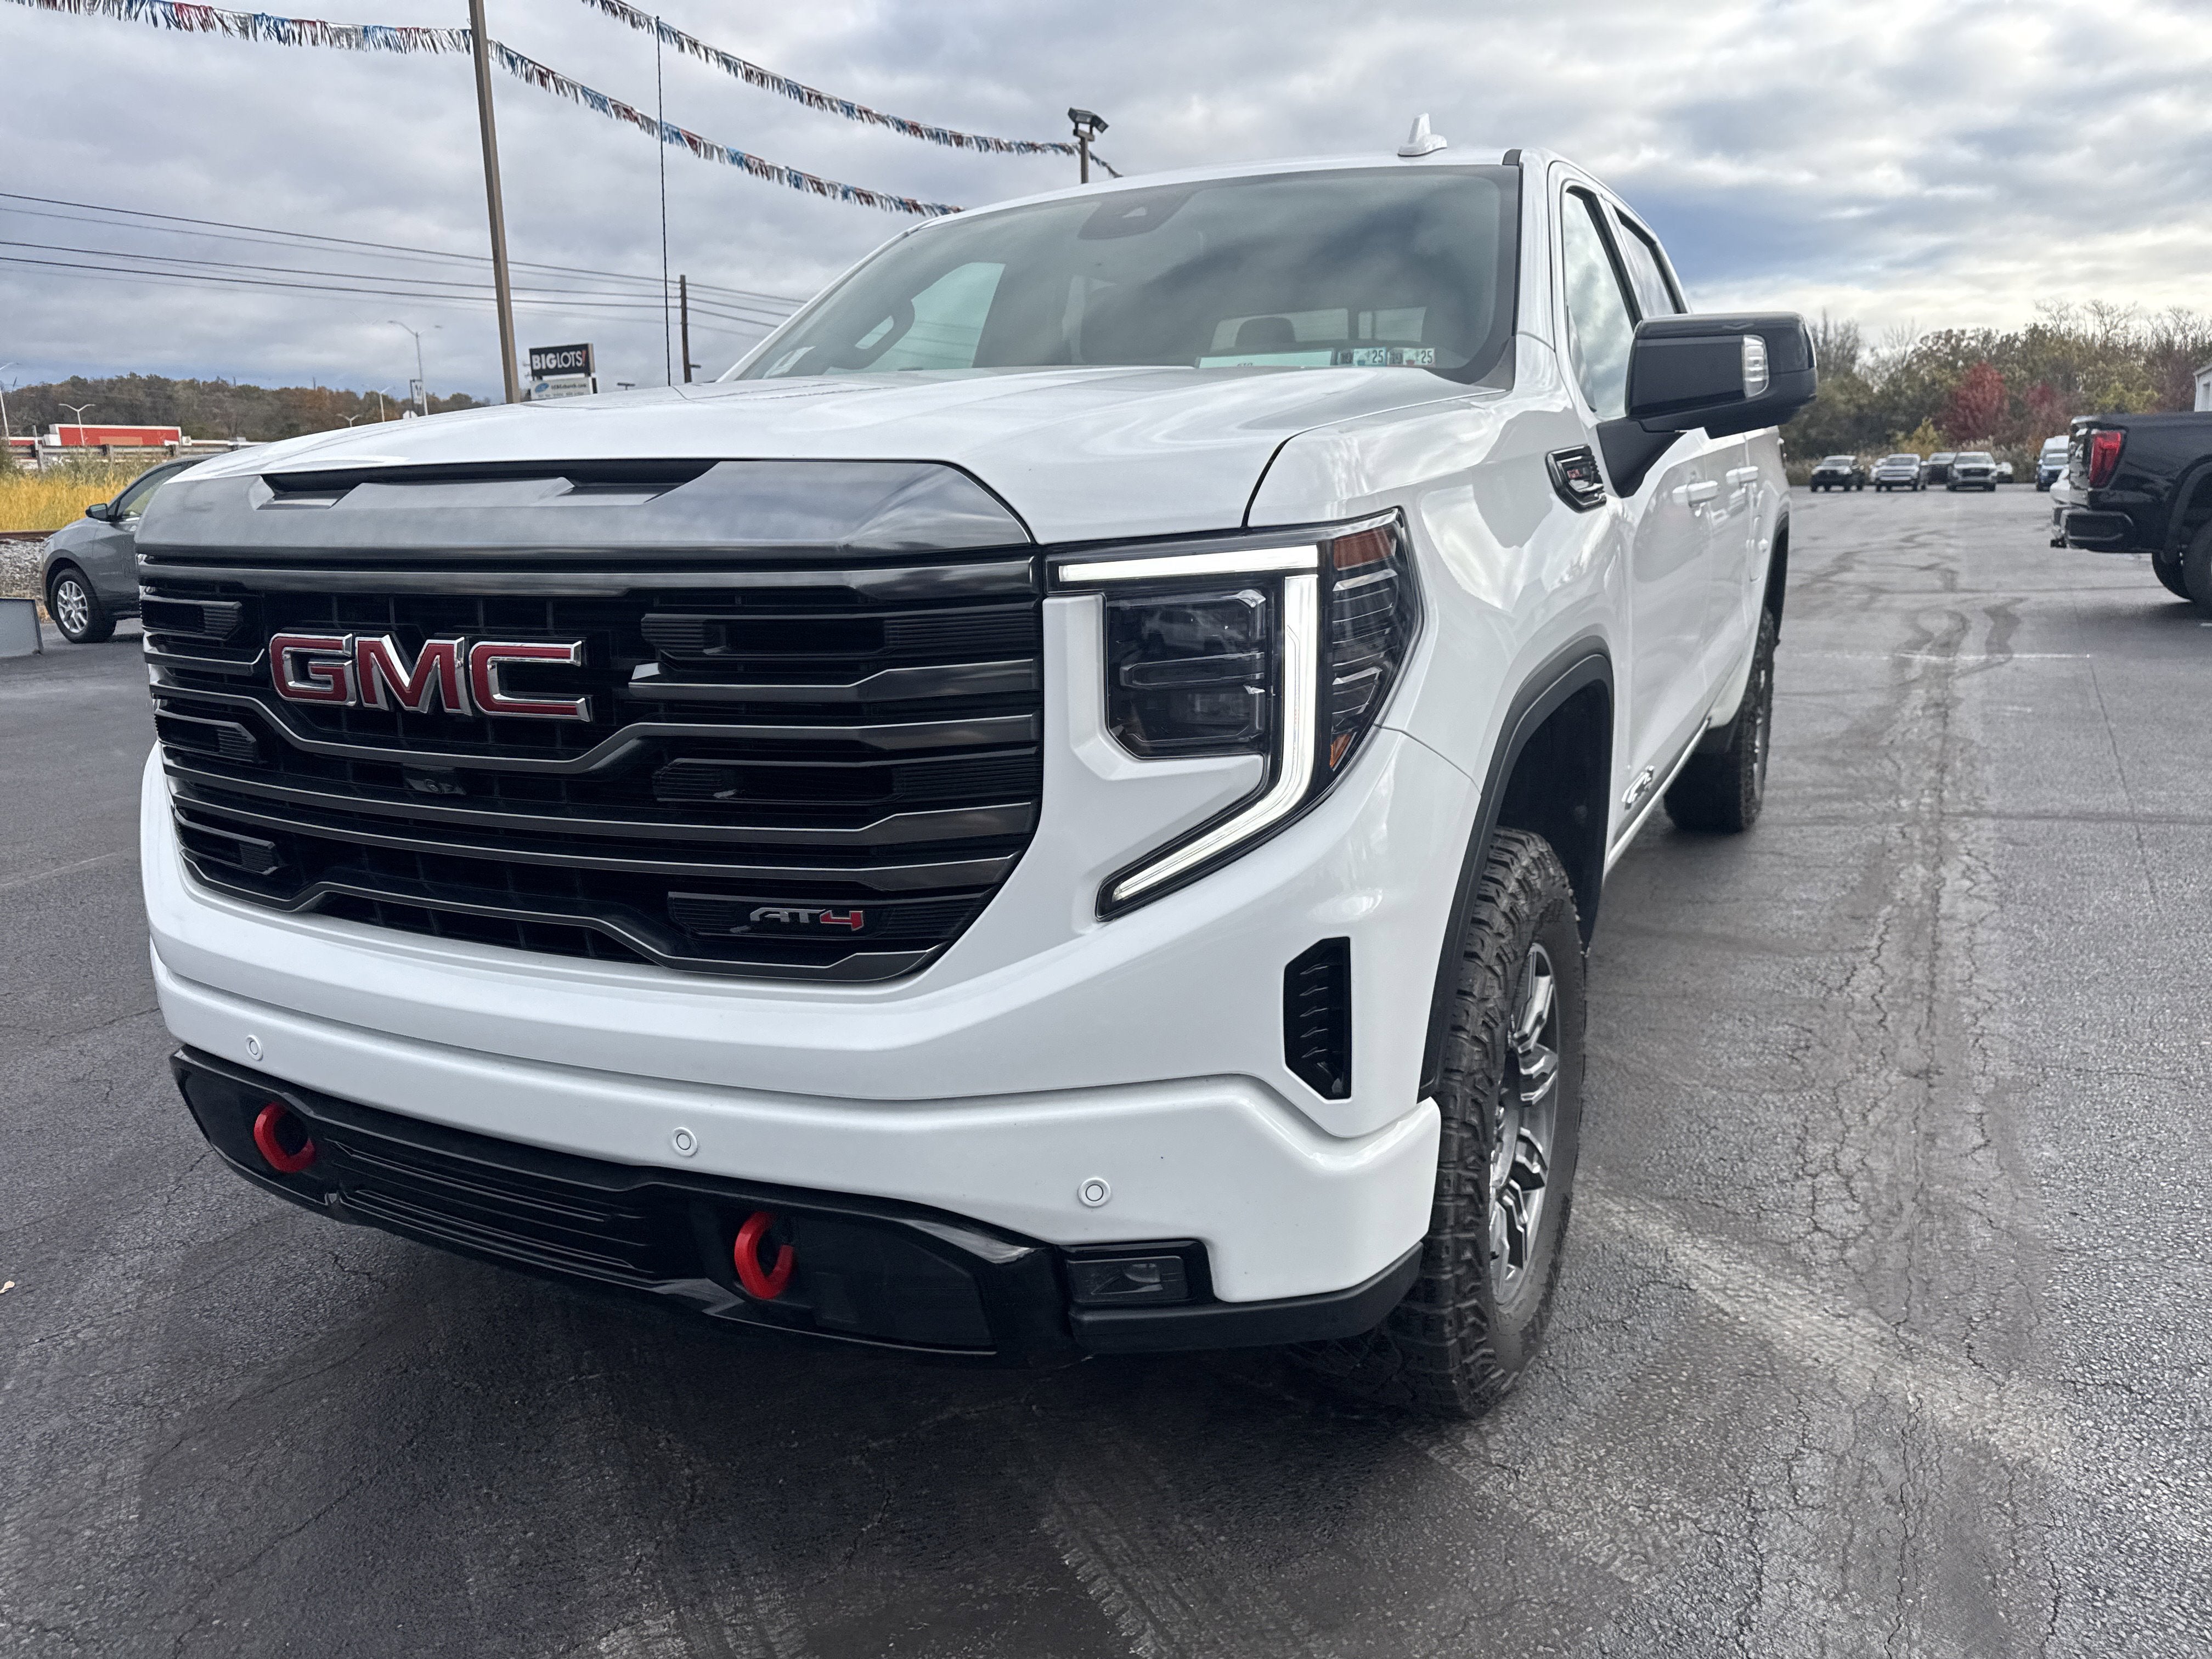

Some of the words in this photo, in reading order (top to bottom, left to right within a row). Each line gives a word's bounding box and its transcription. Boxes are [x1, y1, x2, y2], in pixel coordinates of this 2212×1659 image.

[1373, 349, 1384, 364] 25
[1421, 350, 1432, 364] 25
[269, 633, 591, 722] GMC
[750, 906, 865, 932] AT4
